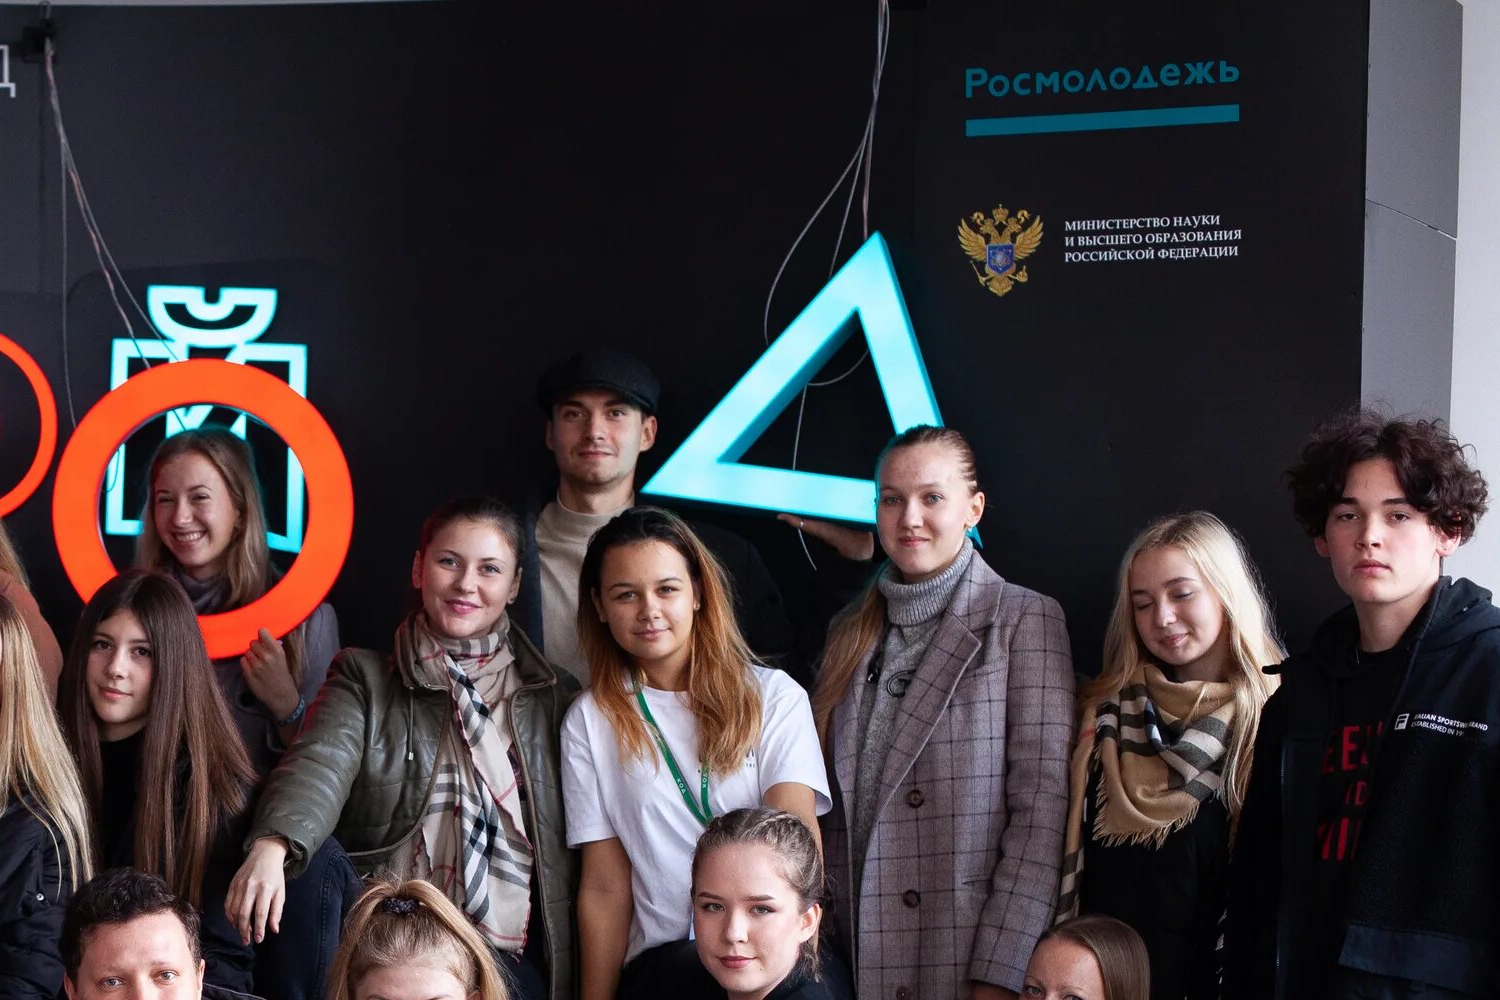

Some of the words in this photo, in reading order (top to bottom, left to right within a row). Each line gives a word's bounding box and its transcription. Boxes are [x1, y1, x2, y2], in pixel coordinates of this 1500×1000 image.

[965, 60, 1240, 98] Росмолодежь
[1064, 216, 1170, 232] МИНИСТЕРСТВО
[1173, 214, 1220, 229] НАУКИ
[1064, 236, 1075, 247] И
[1078, 233, 1143, 247] ВЫСШЕГО
[1145, 229, 1242, 244] ОБРАЗОВАНИЯ
[1064, 247, 1155, 263] РОССИЙСКОЙ
[1157, 245, 1239, 261] ФЕДЕРАЦИИ
